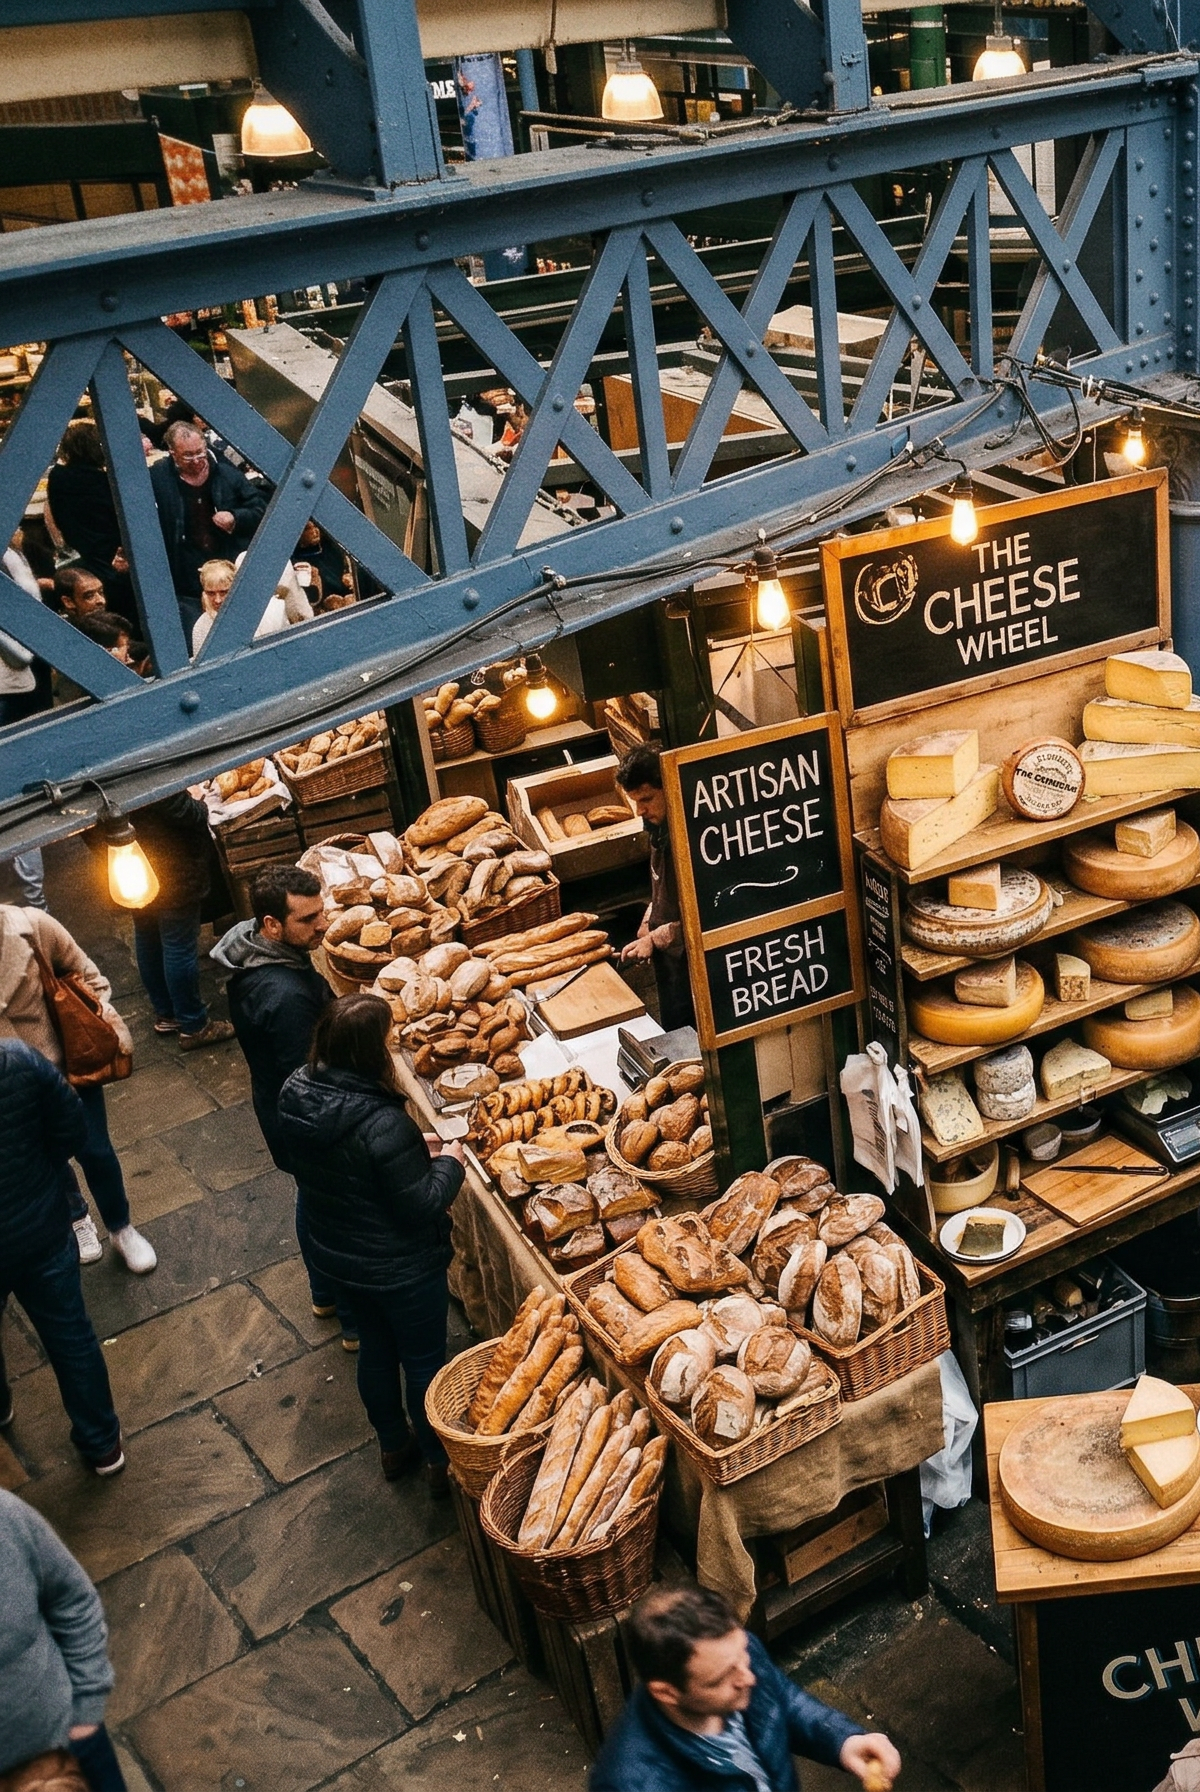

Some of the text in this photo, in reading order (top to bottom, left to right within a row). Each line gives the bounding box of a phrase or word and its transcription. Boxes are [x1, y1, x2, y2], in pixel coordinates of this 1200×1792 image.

[971, 532, 1032, 573] THE
[924, 558, 1081, 635] CHEESE
[956, 616, 1058, 666] WHEEL
[693, 750, 820, 818] ARTISAN
[699, 797, 824, 865] CHEESE
[725, 925, 826, 983] FRESH
[732, 963, 829, 1018] BREAD
